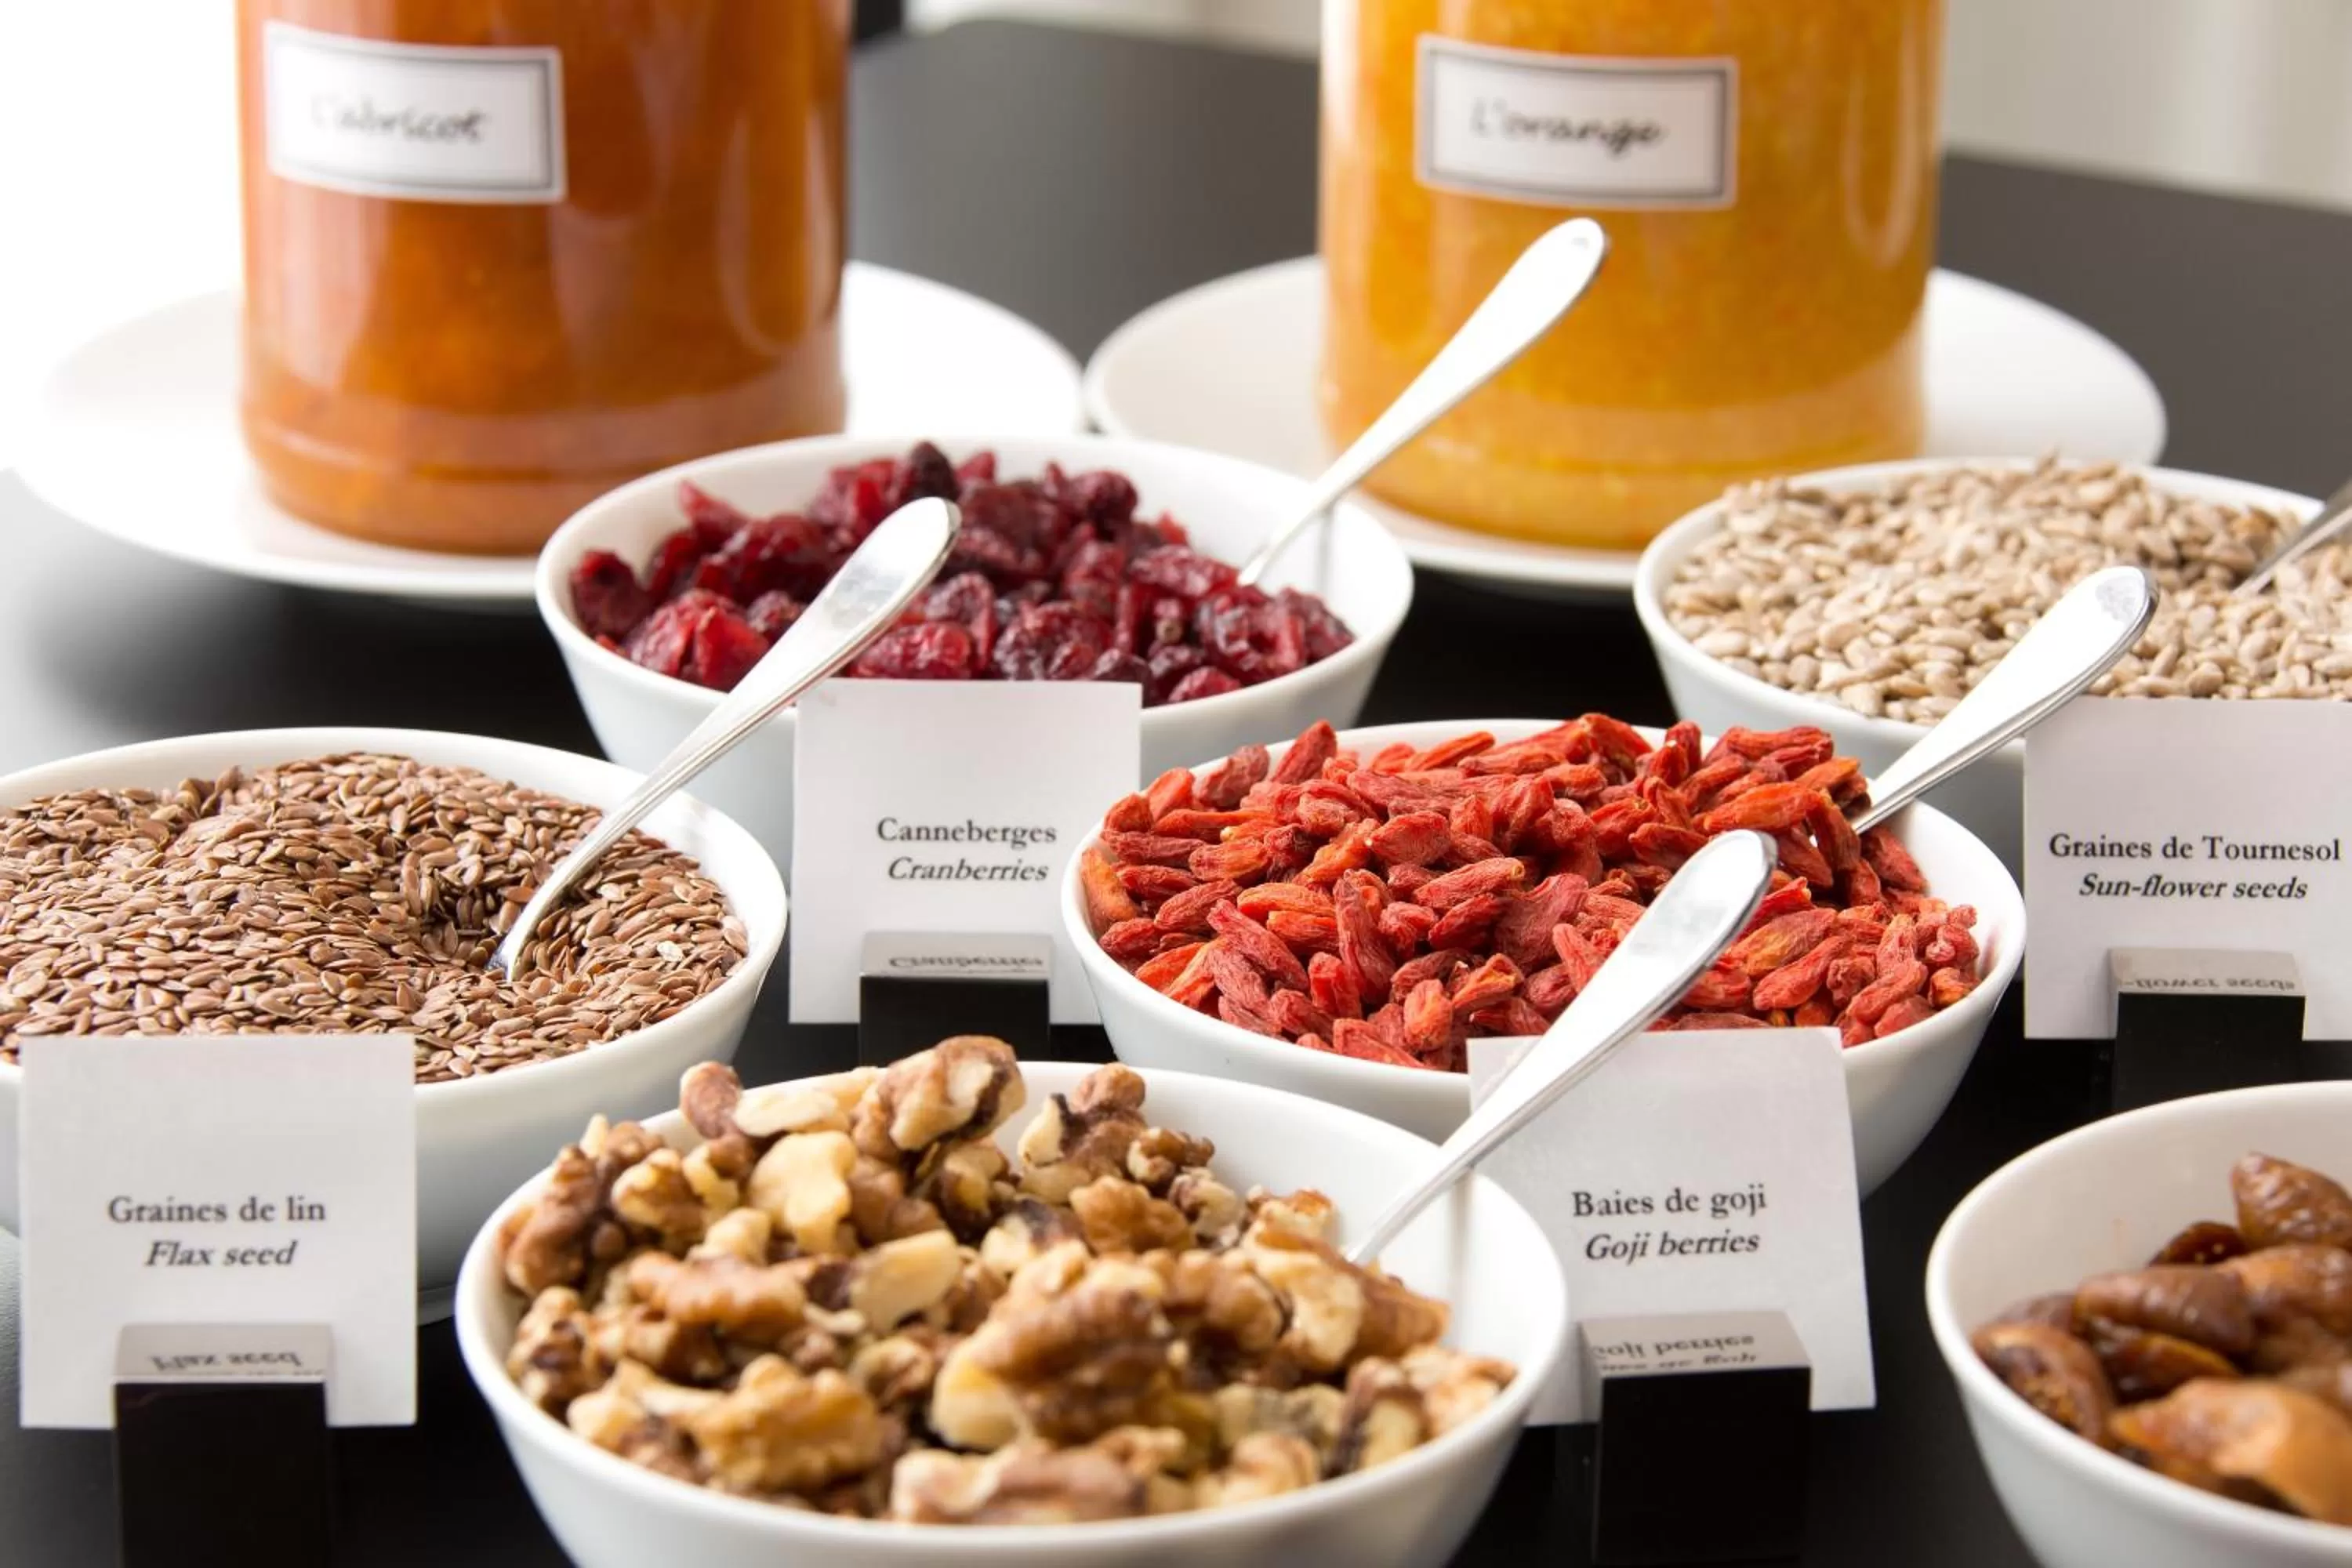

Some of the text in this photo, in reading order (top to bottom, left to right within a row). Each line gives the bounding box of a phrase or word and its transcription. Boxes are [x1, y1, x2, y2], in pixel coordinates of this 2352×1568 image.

[1469, 97, 1665, 158] L'orange
[876, 817, 1058, 849] Canneberges
[2049, 833, 2341, 862] Graines de Tournesol
[887, 856, 1049, 881] Cranberries
[2079, 872, 2308, 899] Sun-flower seeds
[107, 1195, 328, 1224] Graines de lin
[1573, 1183, 1767, 1220] Baies de goji
[144, 1239, 299, 1267] Flax seed
[1584, 1228, 1761, 1266] Goji berries
